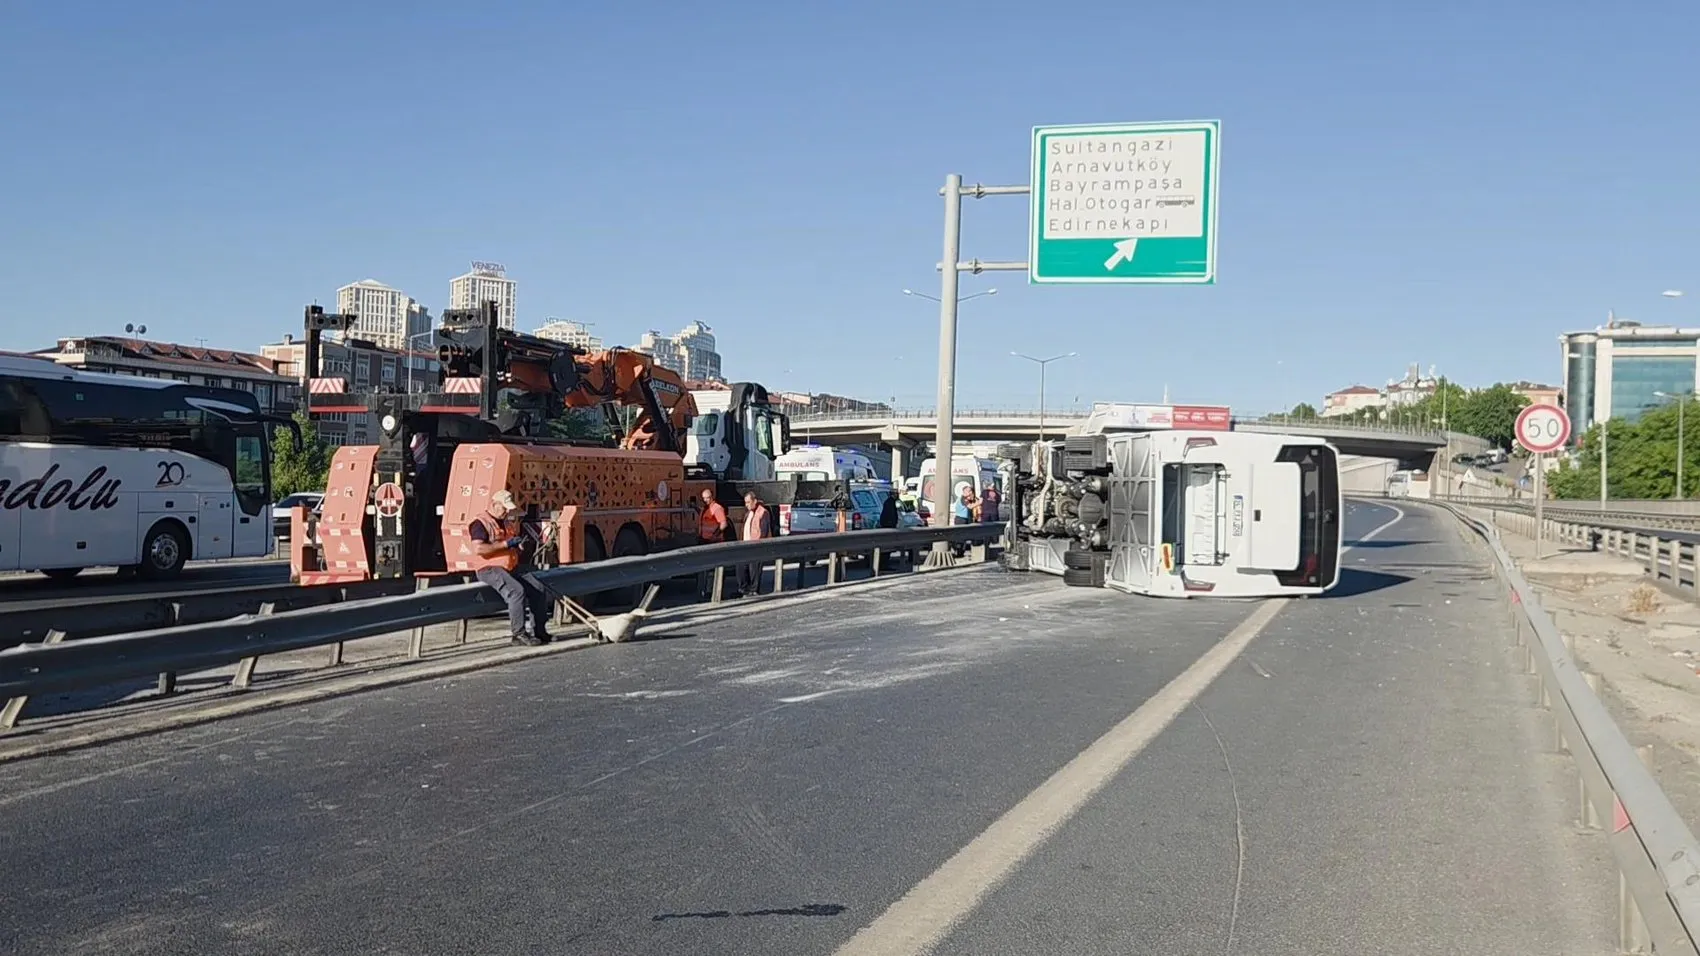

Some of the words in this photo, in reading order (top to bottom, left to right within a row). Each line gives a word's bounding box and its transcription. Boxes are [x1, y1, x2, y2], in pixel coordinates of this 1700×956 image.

[1051, 137, 1172, 155] Sultangazi
[1051, 157, 1172, 174] Arnavutköy
[1050, 177, 1182, 194] Bayrampaşa
[1086, 197, 1151, 213] Otogar
[1049, 216, 1168, 234] Edirnekapı
[471, 260, 505, 272] VENEZIA
[1528, 418, 1559, 438] 50
[157, 461, 185, 486] 20
